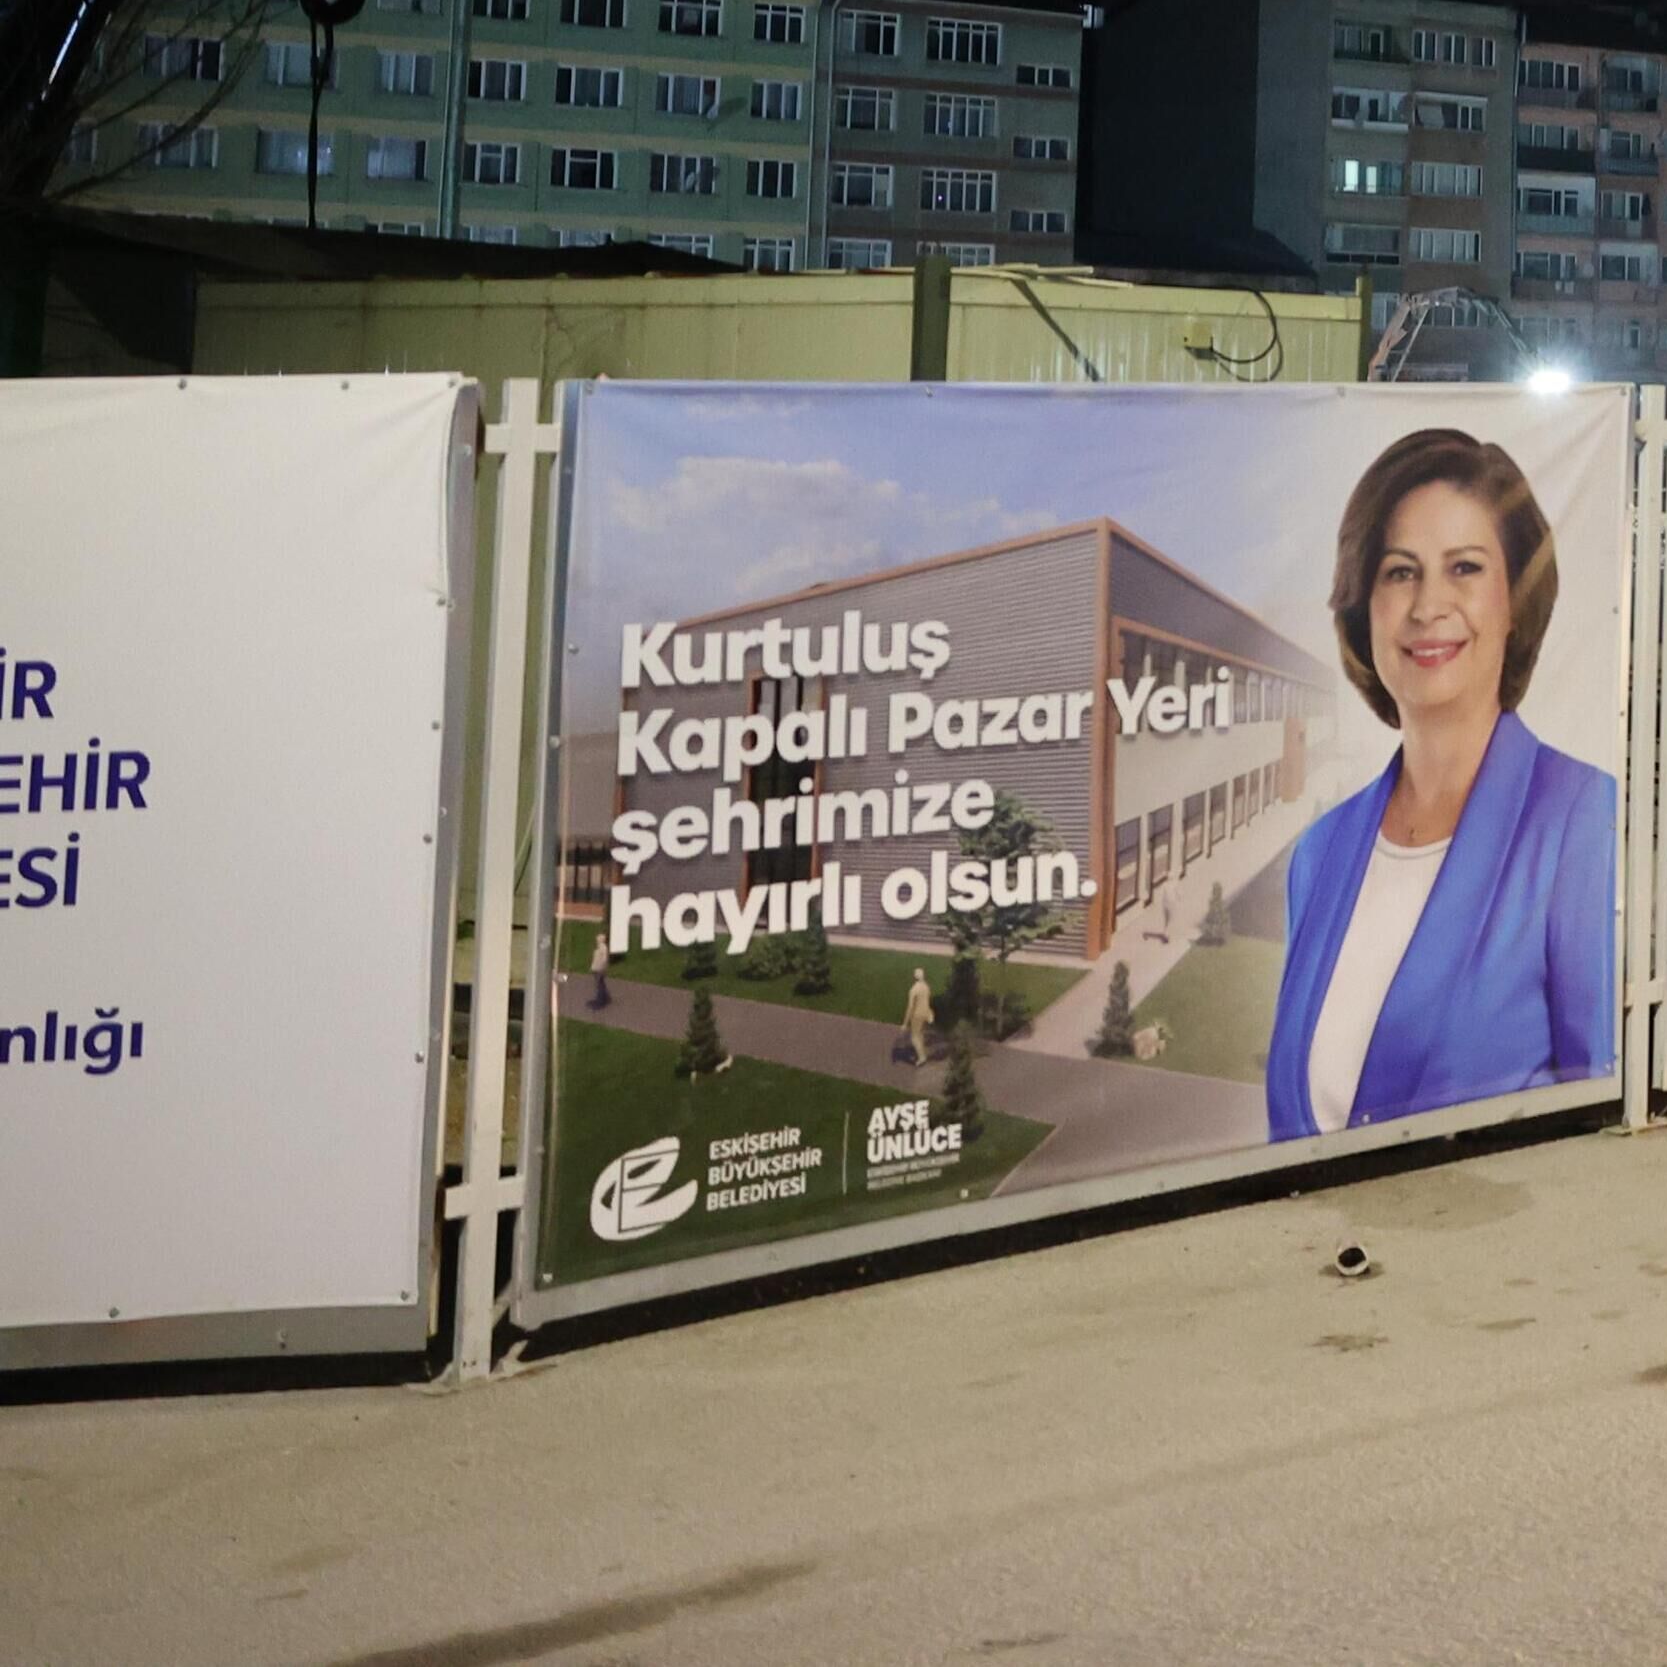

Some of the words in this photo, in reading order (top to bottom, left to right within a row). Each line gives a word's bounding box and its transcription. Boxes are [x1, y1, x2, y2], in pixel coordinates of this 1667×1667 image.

[620, 610, 951, 688] Kurtuluş
[616, 694, 867, 781] Kapalı
[887, 690, 1093, 754] Pazar
[1105, 668, 1232, 737] Yeri
[610, 770, 996, 874] şehrimize
[608, 861, 863, 956] hayırlı
[881, 848, 1099, 922] olsun.
[867, 1100, 931, 1134] AYŞE
[709, 1126, 802, 1161] ESKİŞEHİR
[867, 1124, 963, 1164] ÜNLÜCE
[707, 1147, 823, 1186] BÜYÜKŞEHİR
[706, 1172, 807, 1212] BELEDİYESİ
